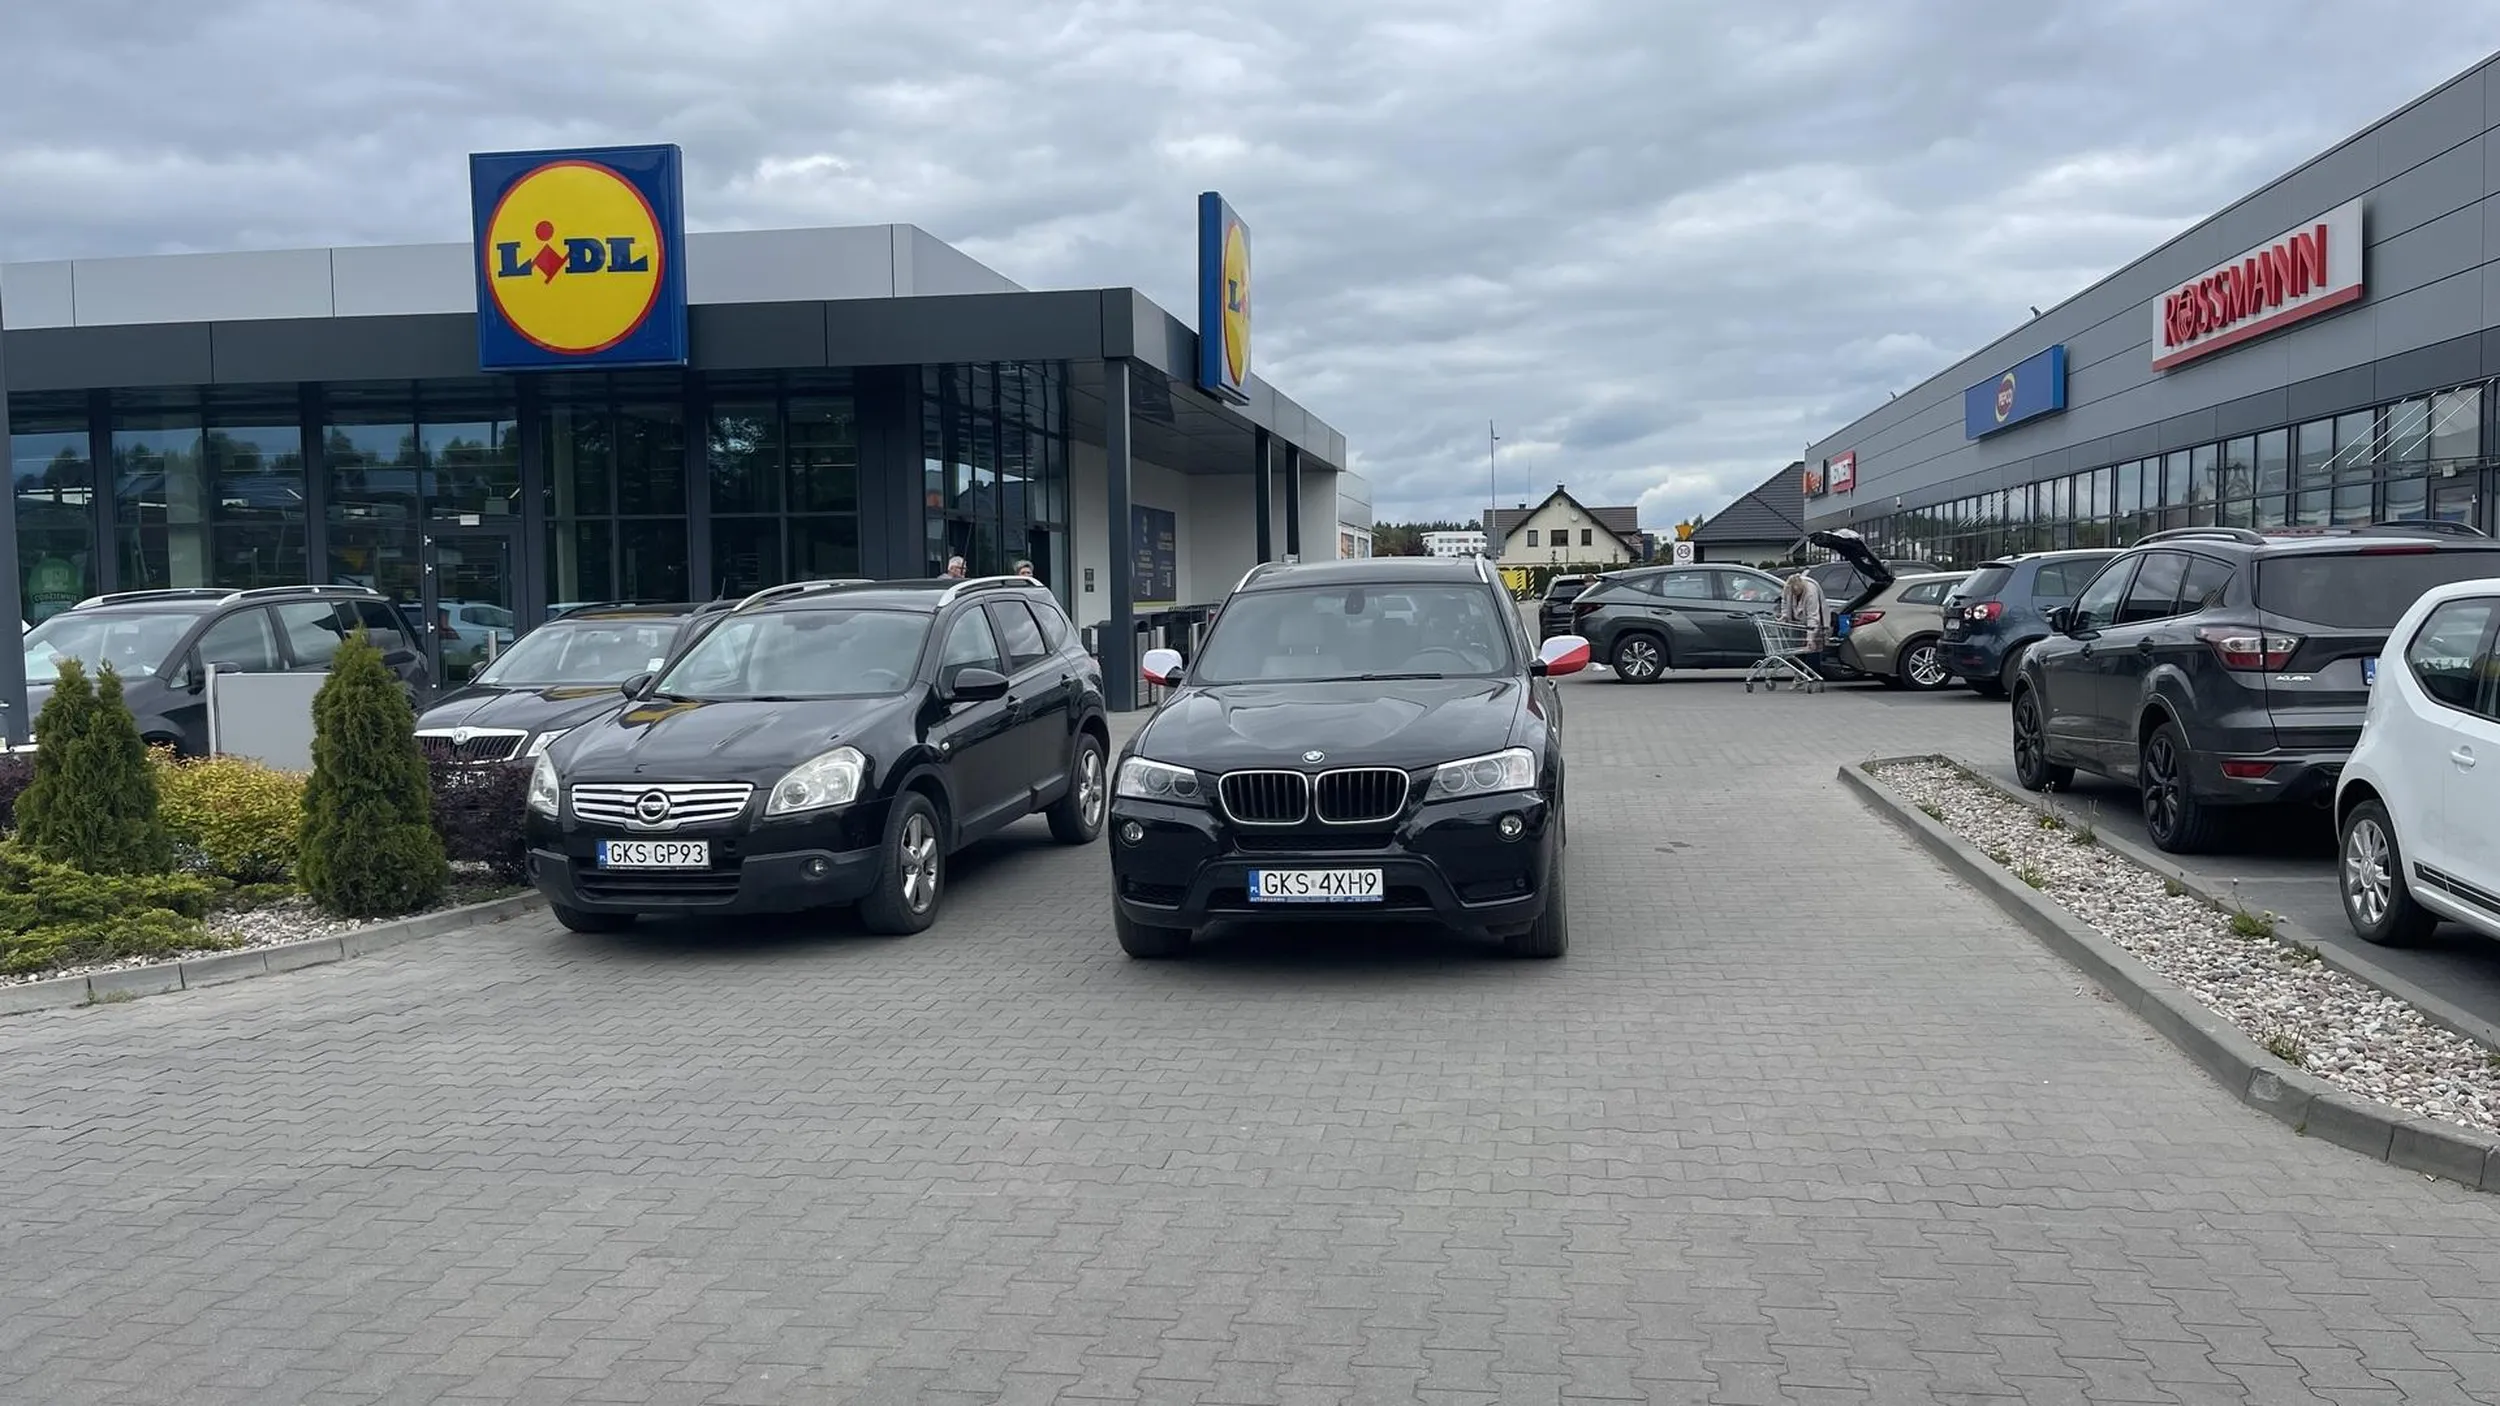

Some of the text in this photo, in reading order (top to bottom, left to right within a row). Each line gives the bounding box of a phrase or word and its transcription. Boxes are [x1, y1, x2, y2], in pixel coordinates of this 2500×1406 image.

[2163, 224, 2328, 347] ROSSMANN
[611, 843, 703, 863] GKS GP93
[1264, 872, 1377, 895] GKS 4XH9
